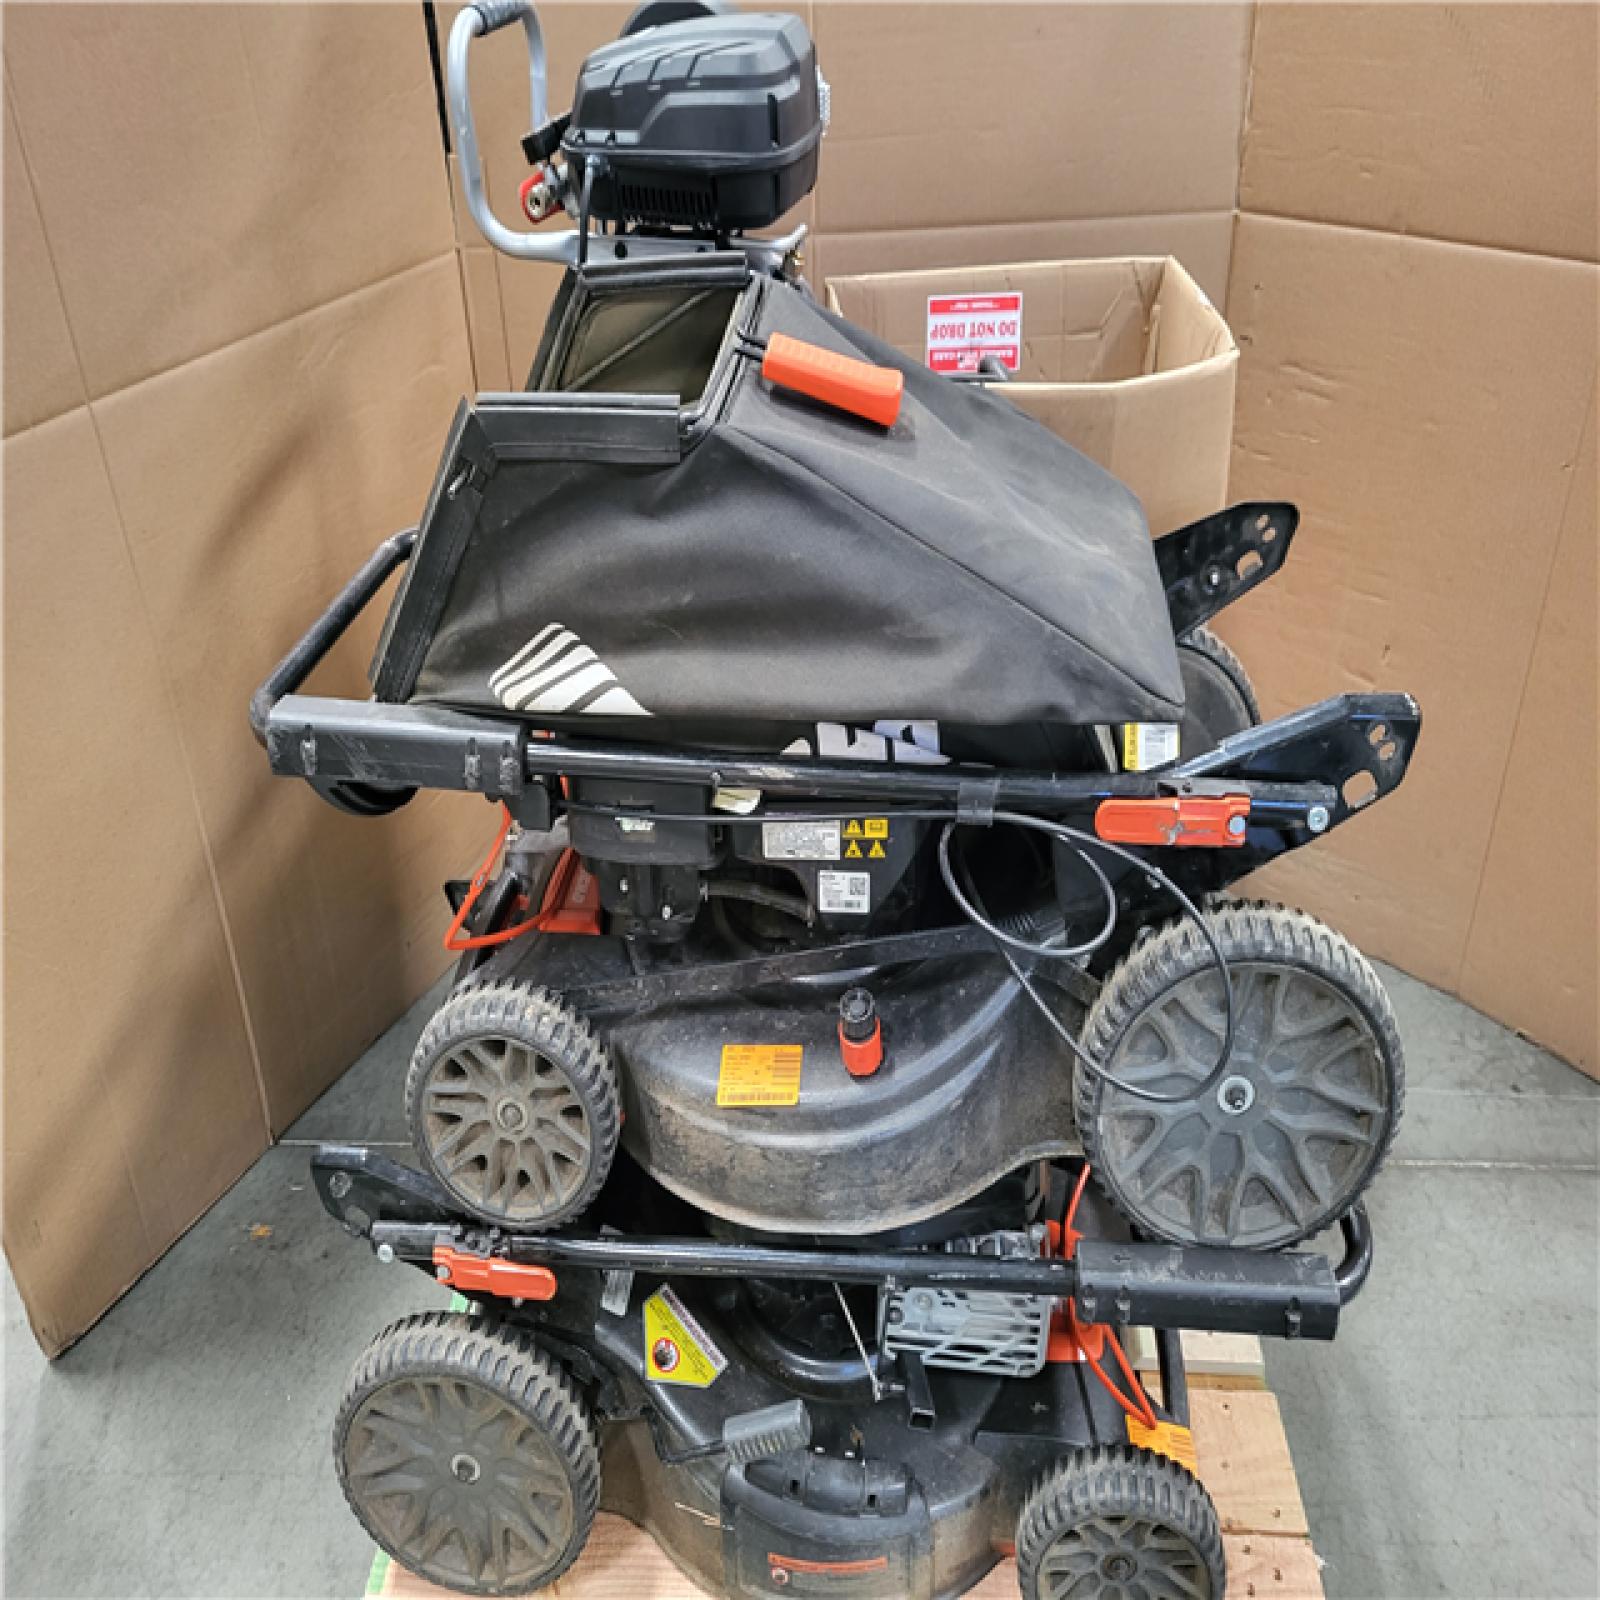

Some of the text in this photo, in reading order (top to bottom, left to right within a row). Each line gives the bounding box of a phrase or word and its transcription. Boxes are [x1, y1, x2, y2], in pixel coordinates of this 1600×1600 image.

[930, 320, 1017, 340] DO NOT DROP
